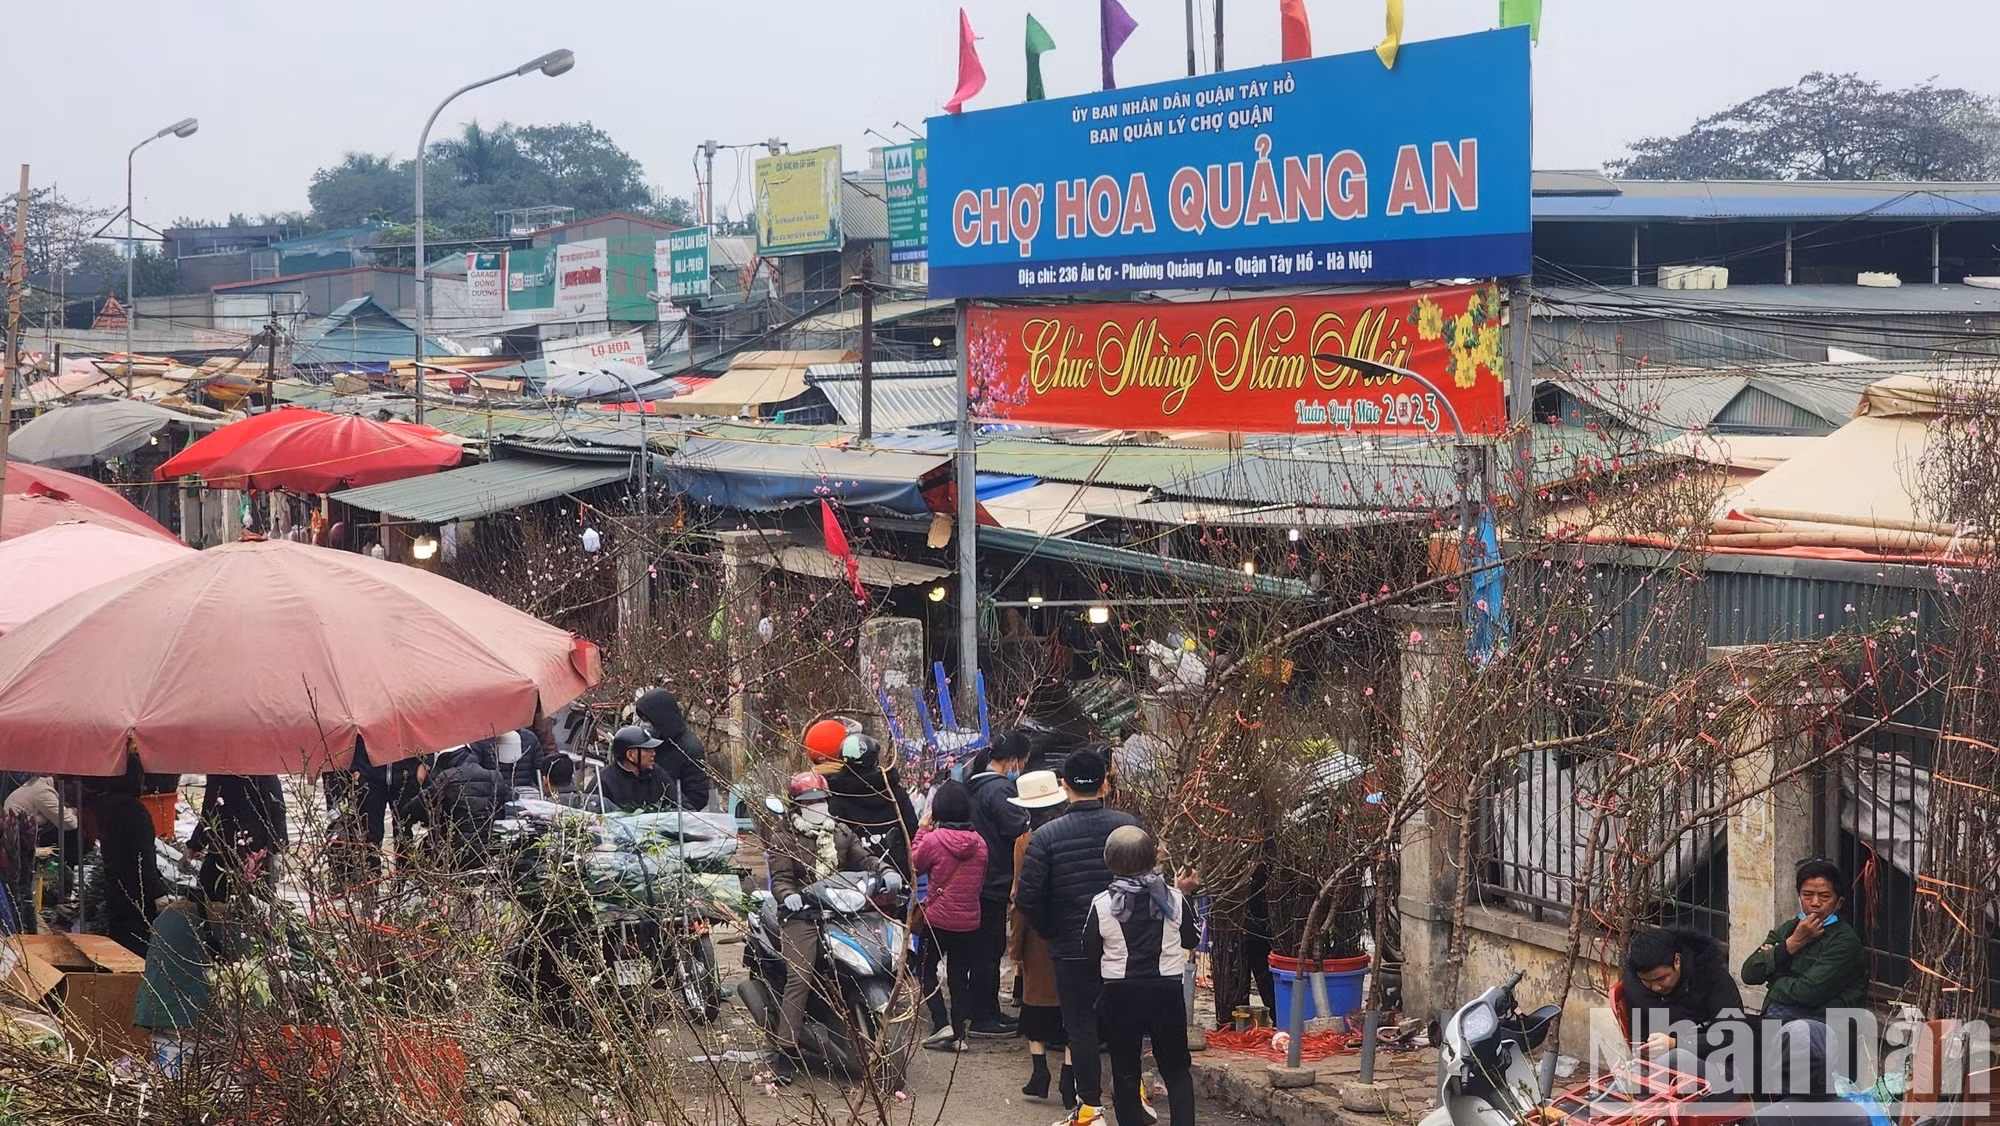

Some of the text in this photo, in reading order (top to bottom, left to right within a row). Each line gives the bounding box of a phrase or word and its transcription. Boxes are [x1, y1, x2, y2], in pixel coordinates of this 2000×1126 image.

[1072, 72, 1296, 123] ỦY BAN NHÂN DÂN QUẬN TÂY HỒ
[1089, 104, 1273, 144] BAN QUẢN LÝ CHỢ QUẬN
[953, 134, 1478, 257] CHỢ HOA QUẢNG AN
[685, 236, 695, 250] LAN
[1018, 267, 1034, 288] Địa
[1038, 265, 1056, 284] chỉ:
[1058, 266, 1078, 283] 236
[1080, 262, 1094, 282] Âu
[1098, 264, 1112, 281] Cơ
[1122, 261, 1164, 280] Phường
[1166, 258, 1204, 279] Quảng
[1206, 258, 1222, 276] An
[1234, 256, 1266, 278] Quận
[1270, 254, 1292, 274] Tây
[1296, 250, 1314, 272] Hồ
[1326, 251, 1344, 270] Hà
[1348, 250, 1372, 273] Nội
[591, 340, 631, 358] LỌ HOA
[1022, 306, 1414, 416] Chúc Mừng Năm Mới
[1295, 393, 1440, 432] Xuân Quý Mão 2023
